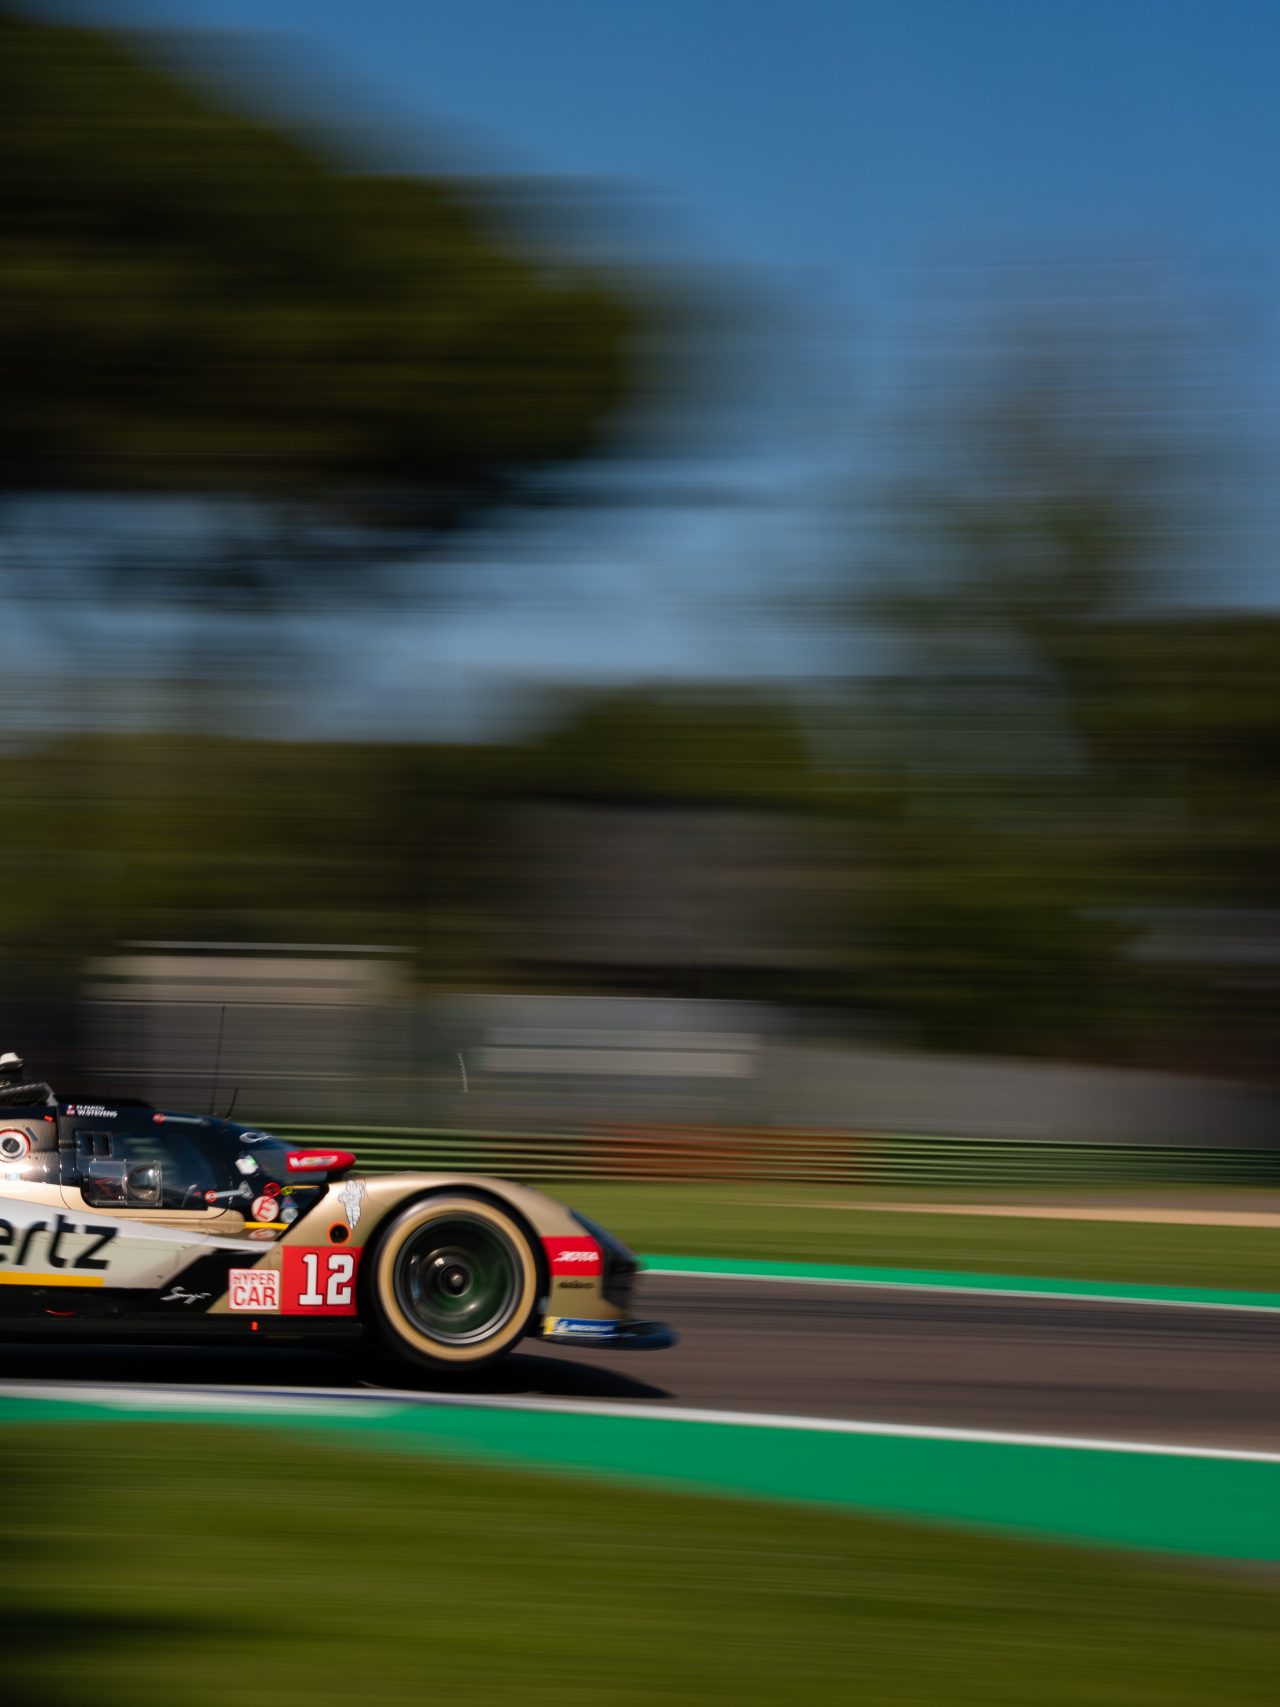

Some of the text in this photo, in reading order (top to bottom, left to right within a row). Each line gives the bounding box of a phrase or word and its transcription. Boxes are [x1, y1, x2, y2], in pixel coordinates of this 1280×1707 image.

[233, 1272, 276, 1286] HYPER
[297, 1253, 355, 1306] 12
[233, 1286, 277, 1307] CAR
